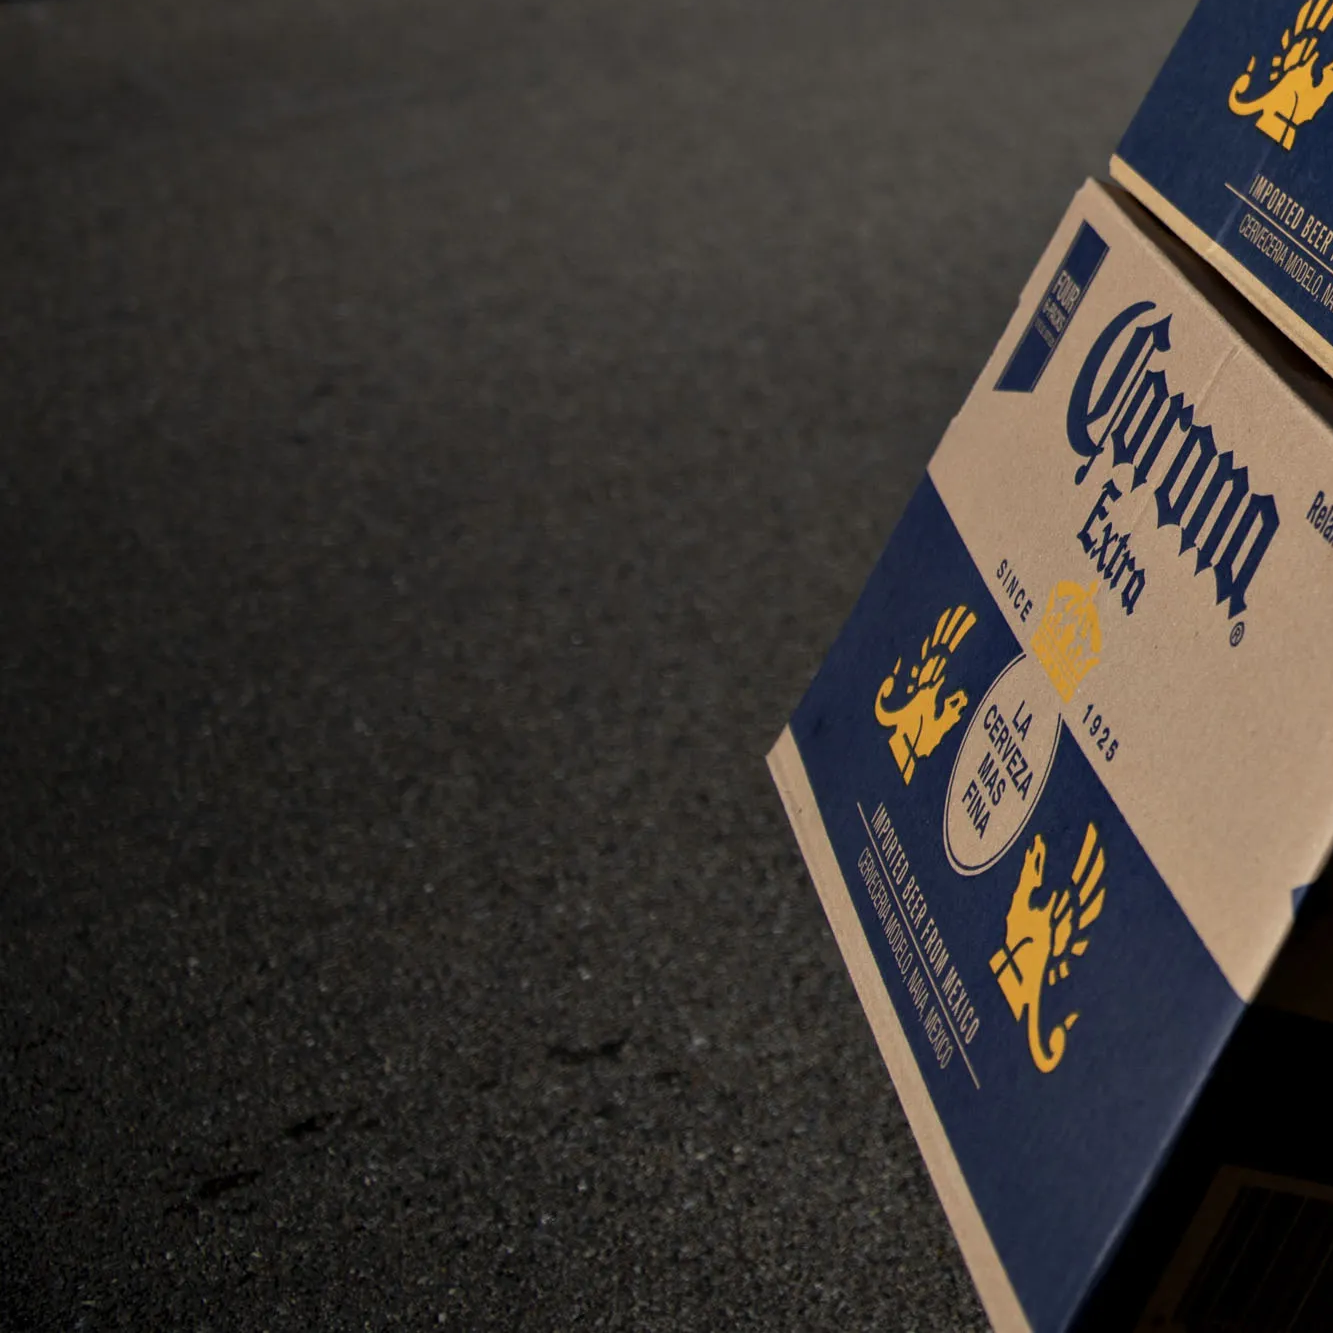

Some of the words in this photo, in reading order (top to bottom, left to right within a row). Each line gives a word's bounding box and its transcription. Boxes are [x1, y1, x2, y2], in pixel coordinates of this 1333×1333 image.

[1248, 173, 1305, 231] IMPORTED
[1238, 213, 1287, 266] CERVECERIA
[1051, 269, 1081, 314] FOUR
[1076, 479, 1146, 615] Extra
[996, 559, 1033, 622] SINCE
[1083, 703, 1120, 762] 1925
[1011, 700, 1034, 742] LA
[977, 752, 1007, 806] MAS
[982, 704, 1035, 801] CERVEZA
[961, 779, 989, 840] FINA
[869, 802, 909, 885] IMPORTED
[902, 870, 927, 926] BEER
[920, 912, 949, 970] FROM
[942, 960, 981, 1044] MEXICO
[857, 846, 893, 924] CERVECERIA
[923, 1007, 952, 1070] MEXICO
